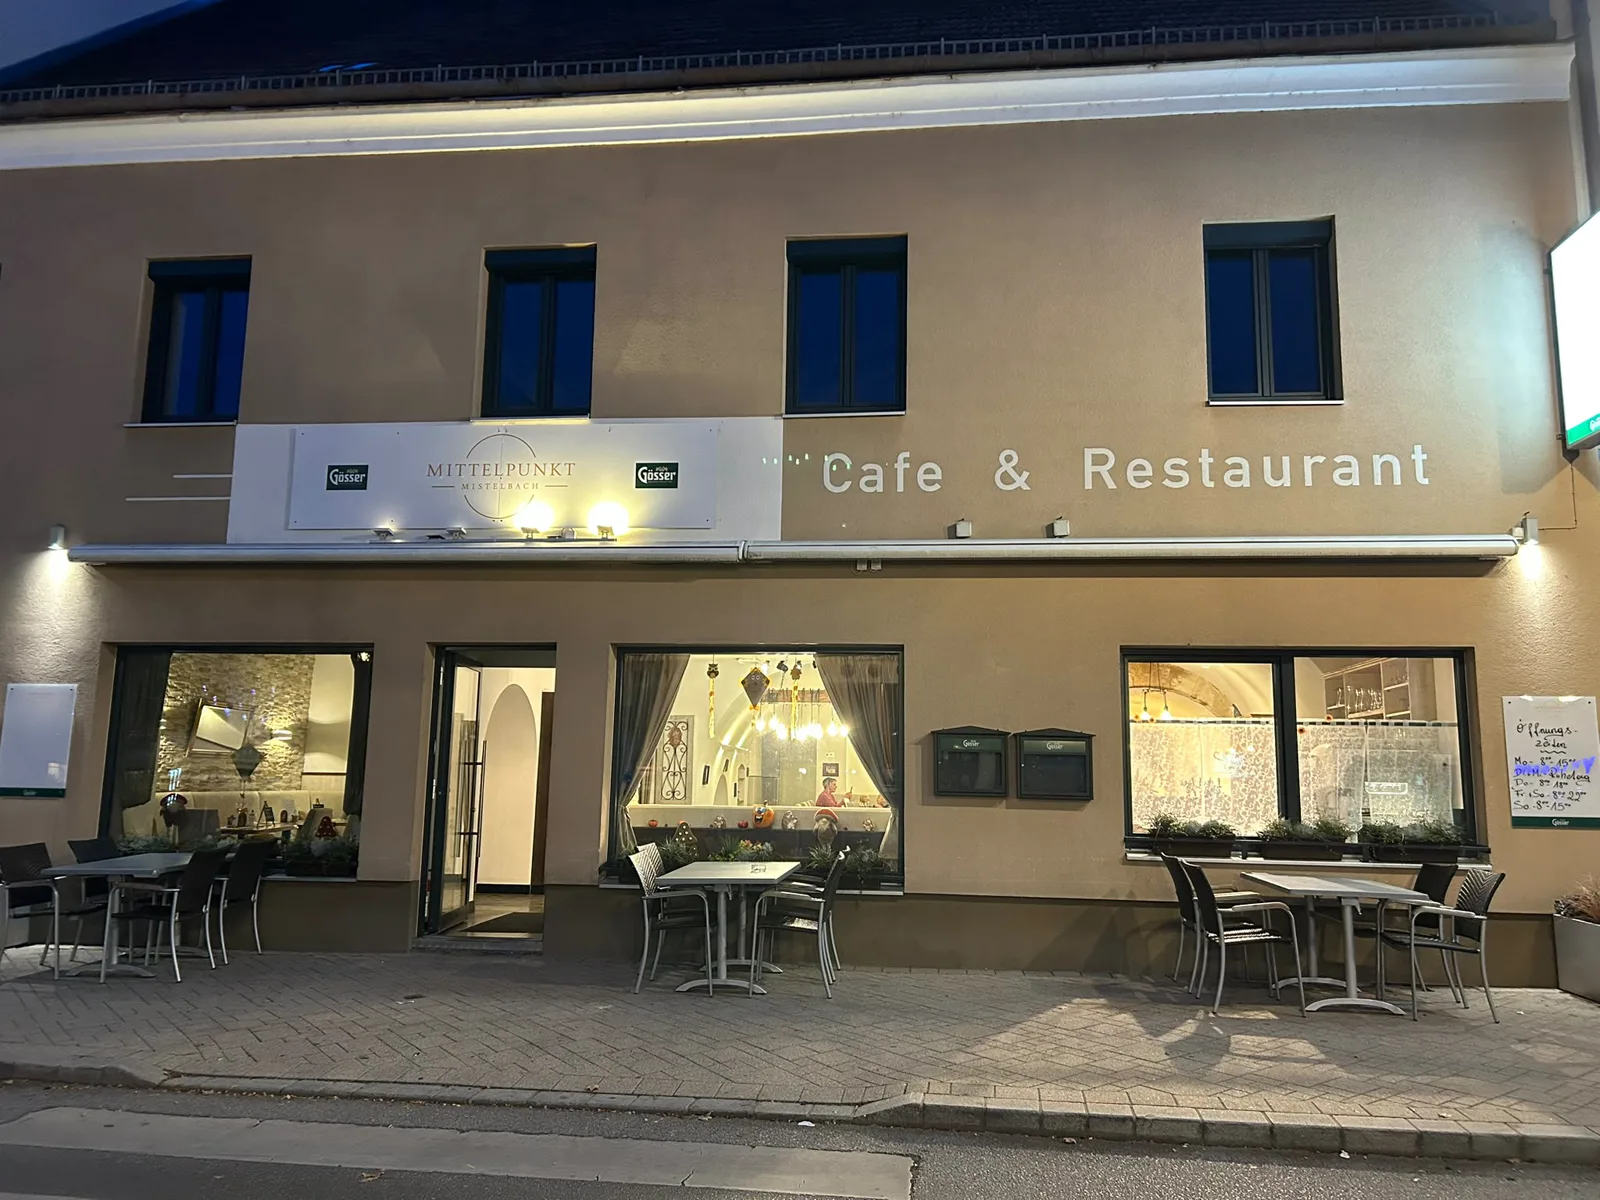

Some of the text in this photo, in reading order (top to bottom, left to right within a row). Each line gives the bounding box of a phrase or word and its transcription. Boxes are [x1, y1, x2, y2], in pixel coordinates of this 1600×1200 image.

[426, 462, 576, 477] MITTELPUNKT
[637, 466, 676, 484] Gösser
[822, 444, 1430, 493] Cafe & Restaurant
[329, 469, 366, 485] Gösser
[461, 482, 539, 490] MISTELBACH
